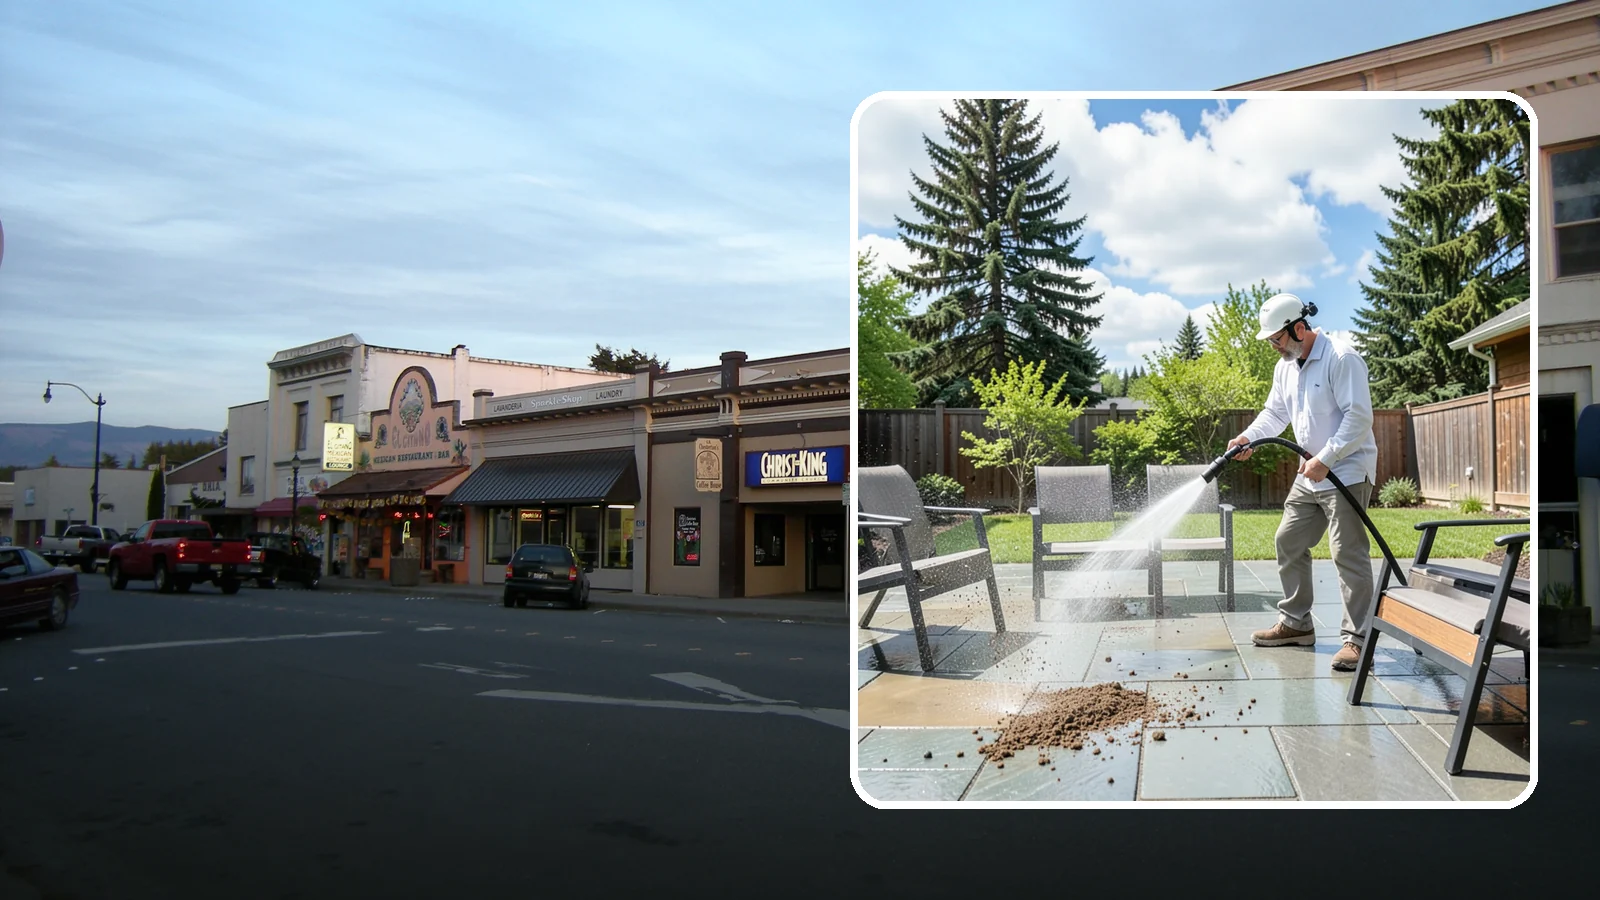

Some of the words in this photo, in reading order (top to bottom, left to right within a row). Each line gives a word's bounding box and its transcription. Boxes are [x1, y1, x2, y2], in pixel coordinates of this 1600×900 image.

[561, 394, 582, 405] Shop
[595, 389, 623, 400] LAUNDRY
[493, 402, 522, 412] LAVANDERIA
[397, 451, 433, 462] RESTAURANT
[437, 450, 450, 459] BAR
[761, 452, 797, 478] CHRIST
[799, 450, 828, 477] KING
